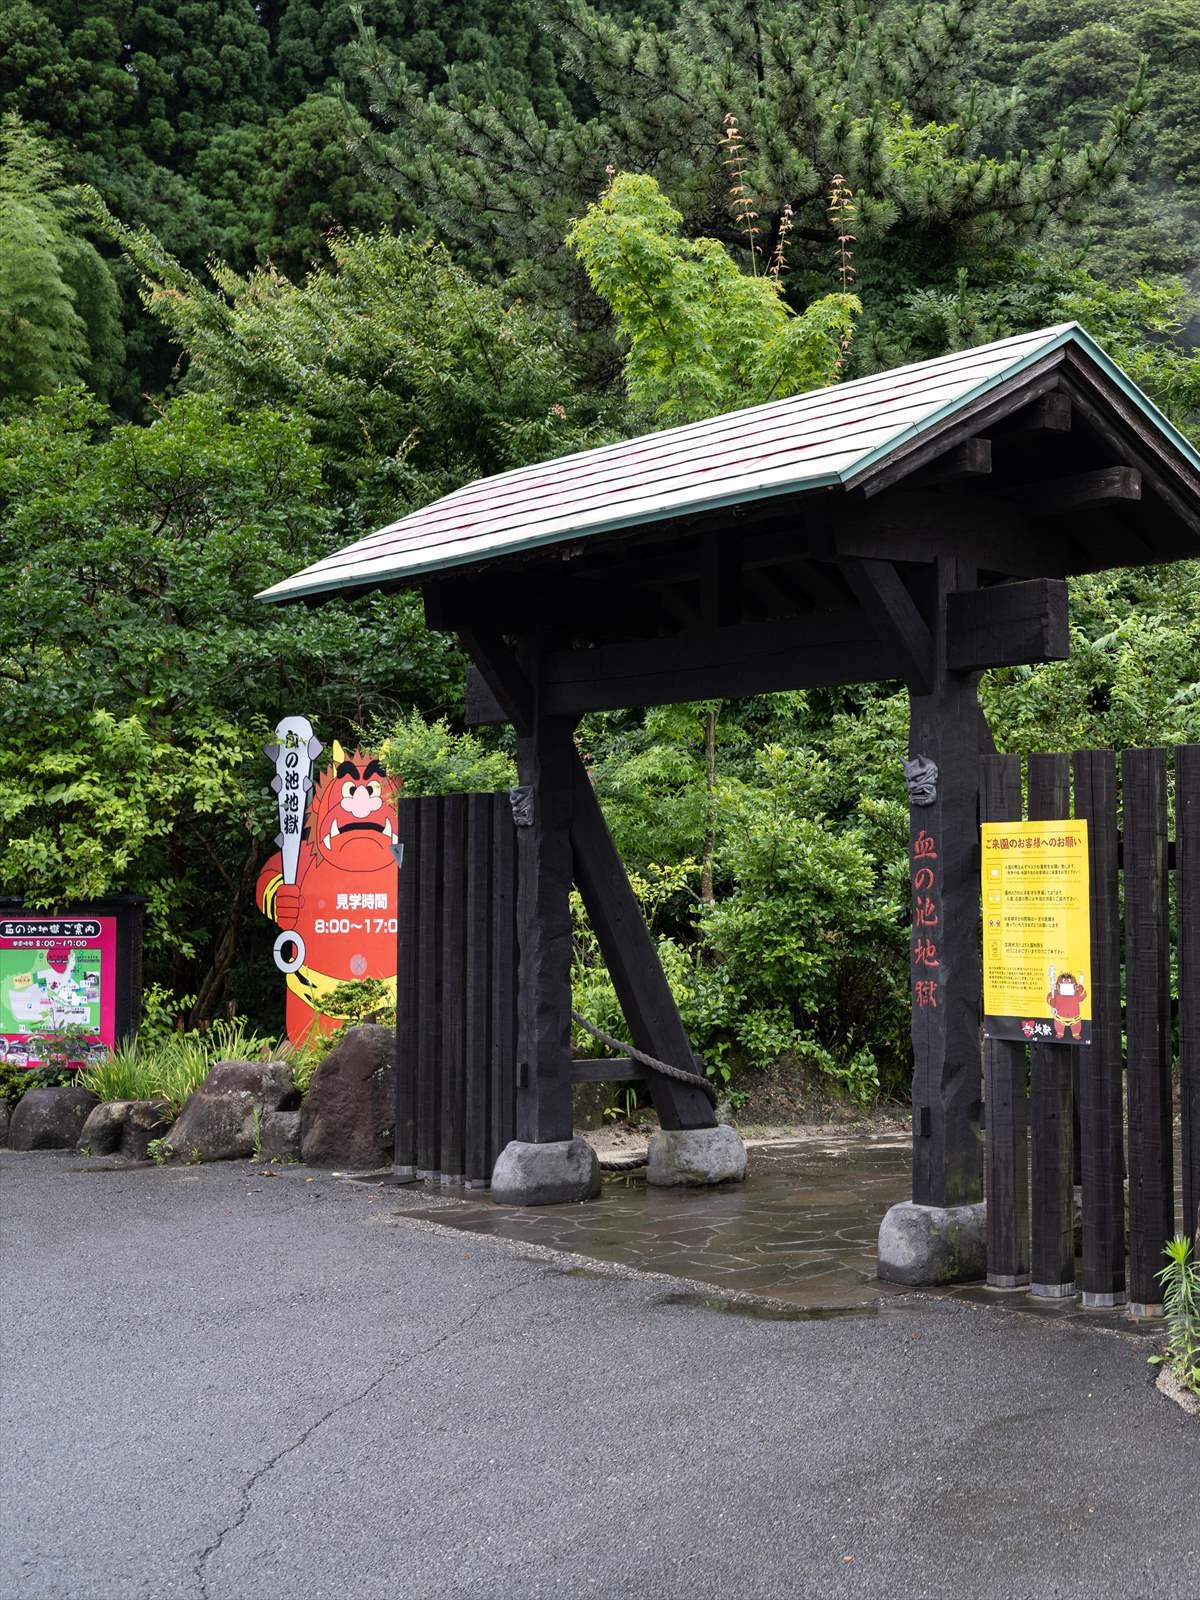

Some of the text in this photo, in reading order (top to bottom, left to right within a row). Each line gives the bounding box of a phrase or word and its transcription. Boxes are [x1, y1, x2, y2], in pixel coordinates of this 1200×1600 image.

[985, 835, 1082, 850] ご来園のお客様へのお願い
[335, 892, 388, 911] 見学時間
[314, 918, 398, 934] 8:00〜17:0
[913, 830, 940, 1008] 血の池地獄
